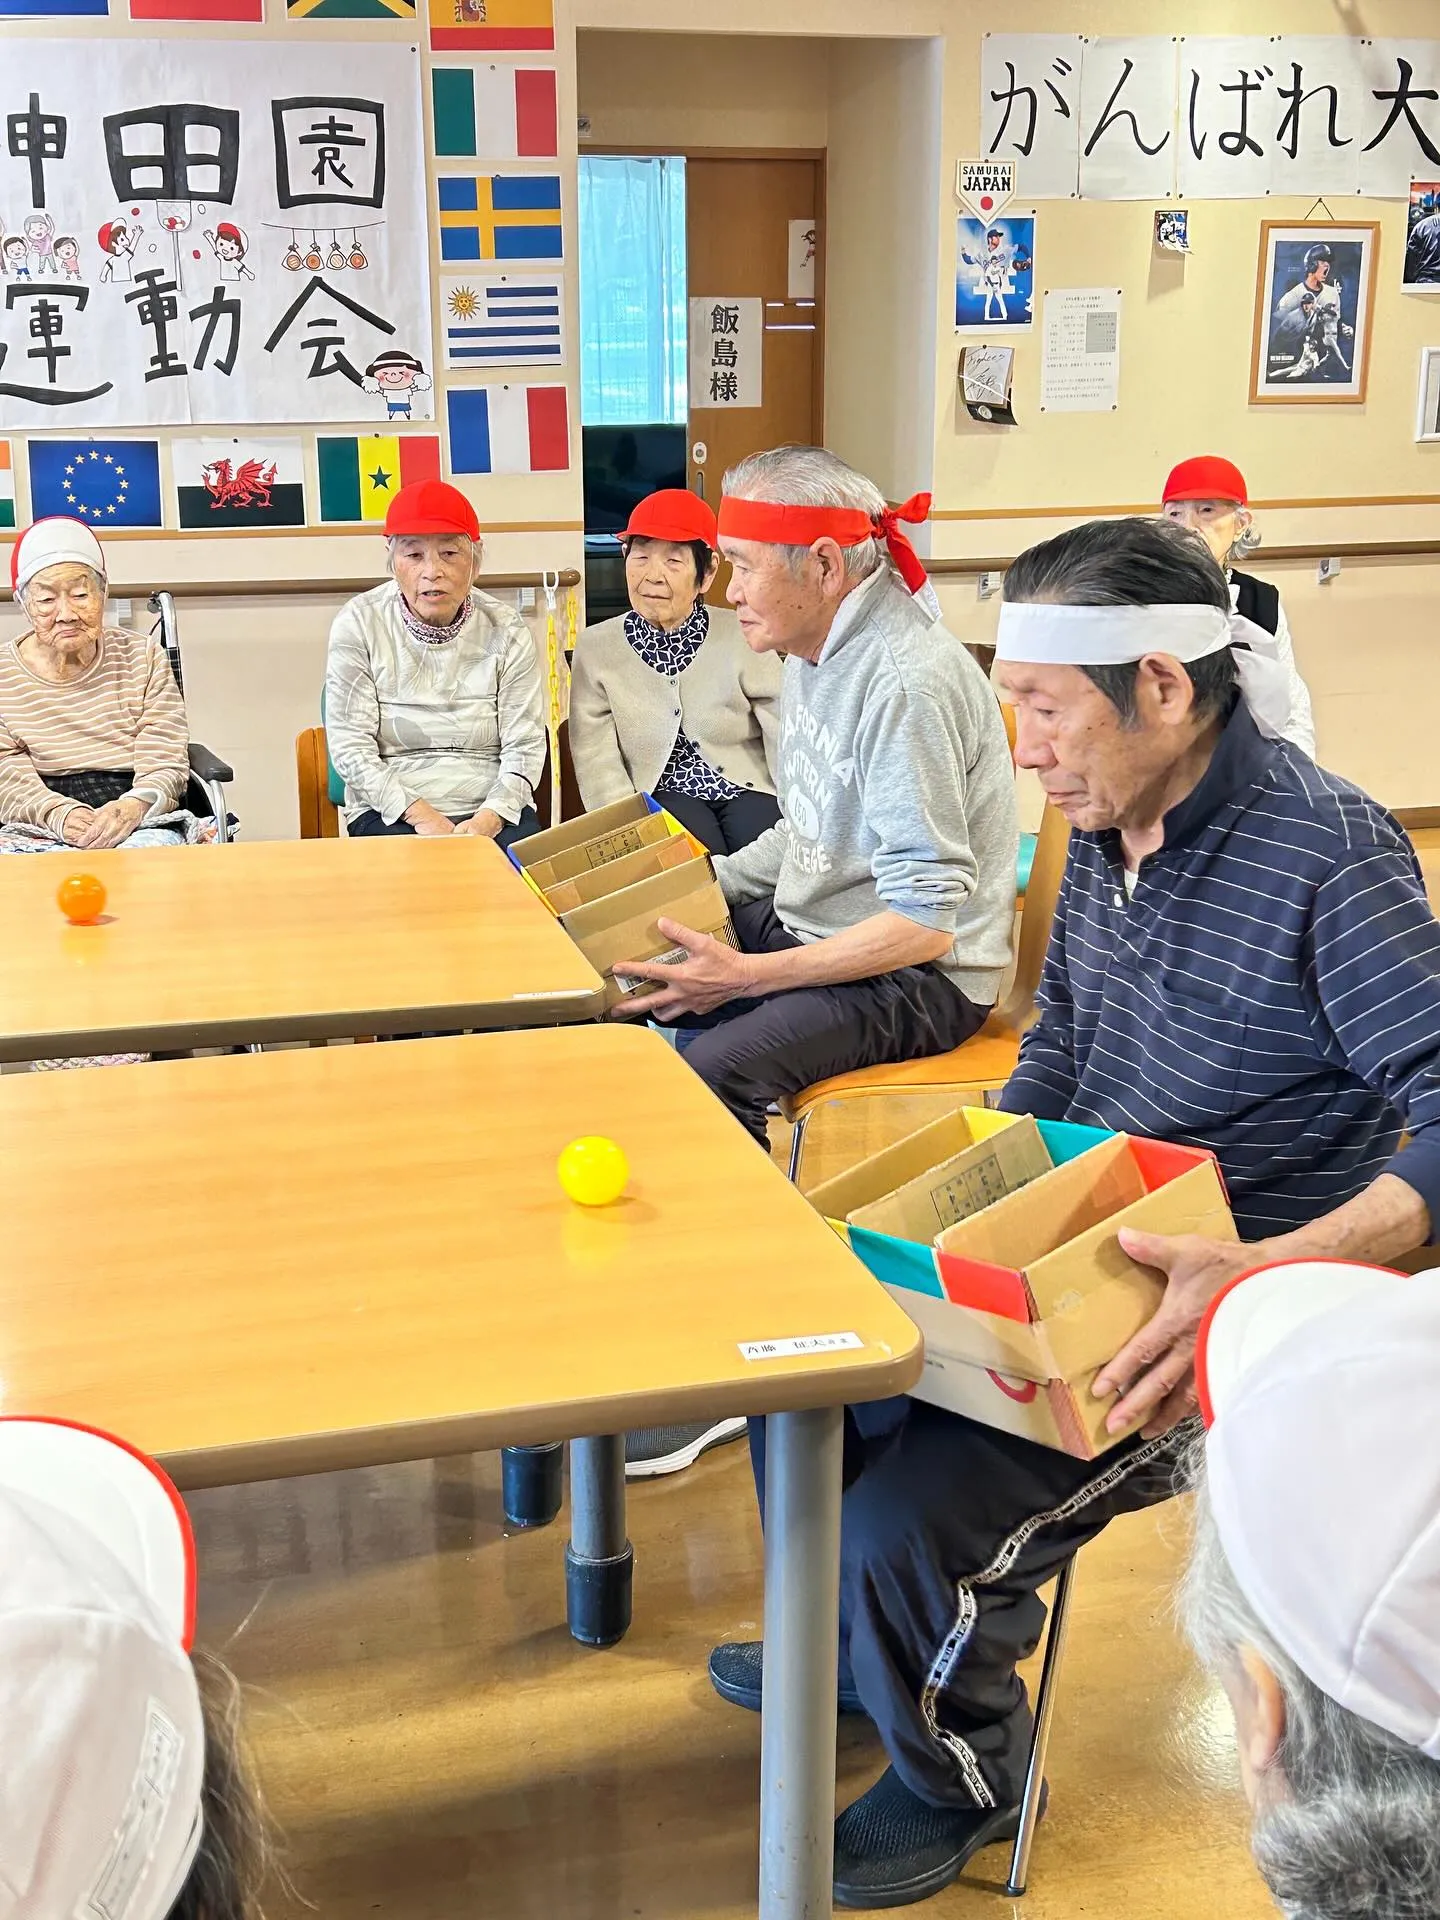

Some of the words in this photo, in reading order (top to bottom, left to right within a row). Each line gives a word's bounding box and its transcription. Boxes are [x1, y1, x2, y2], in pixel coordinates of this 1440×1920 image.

[989, 56, 1440, 166] がんばれ大
[962, 166, 1012, 176] SAMURAI
[962, 177, 1012, 192] JAPAN
[0, 268, 396, 405] 運動会
[710, 304, 739, 401] 飯島様
